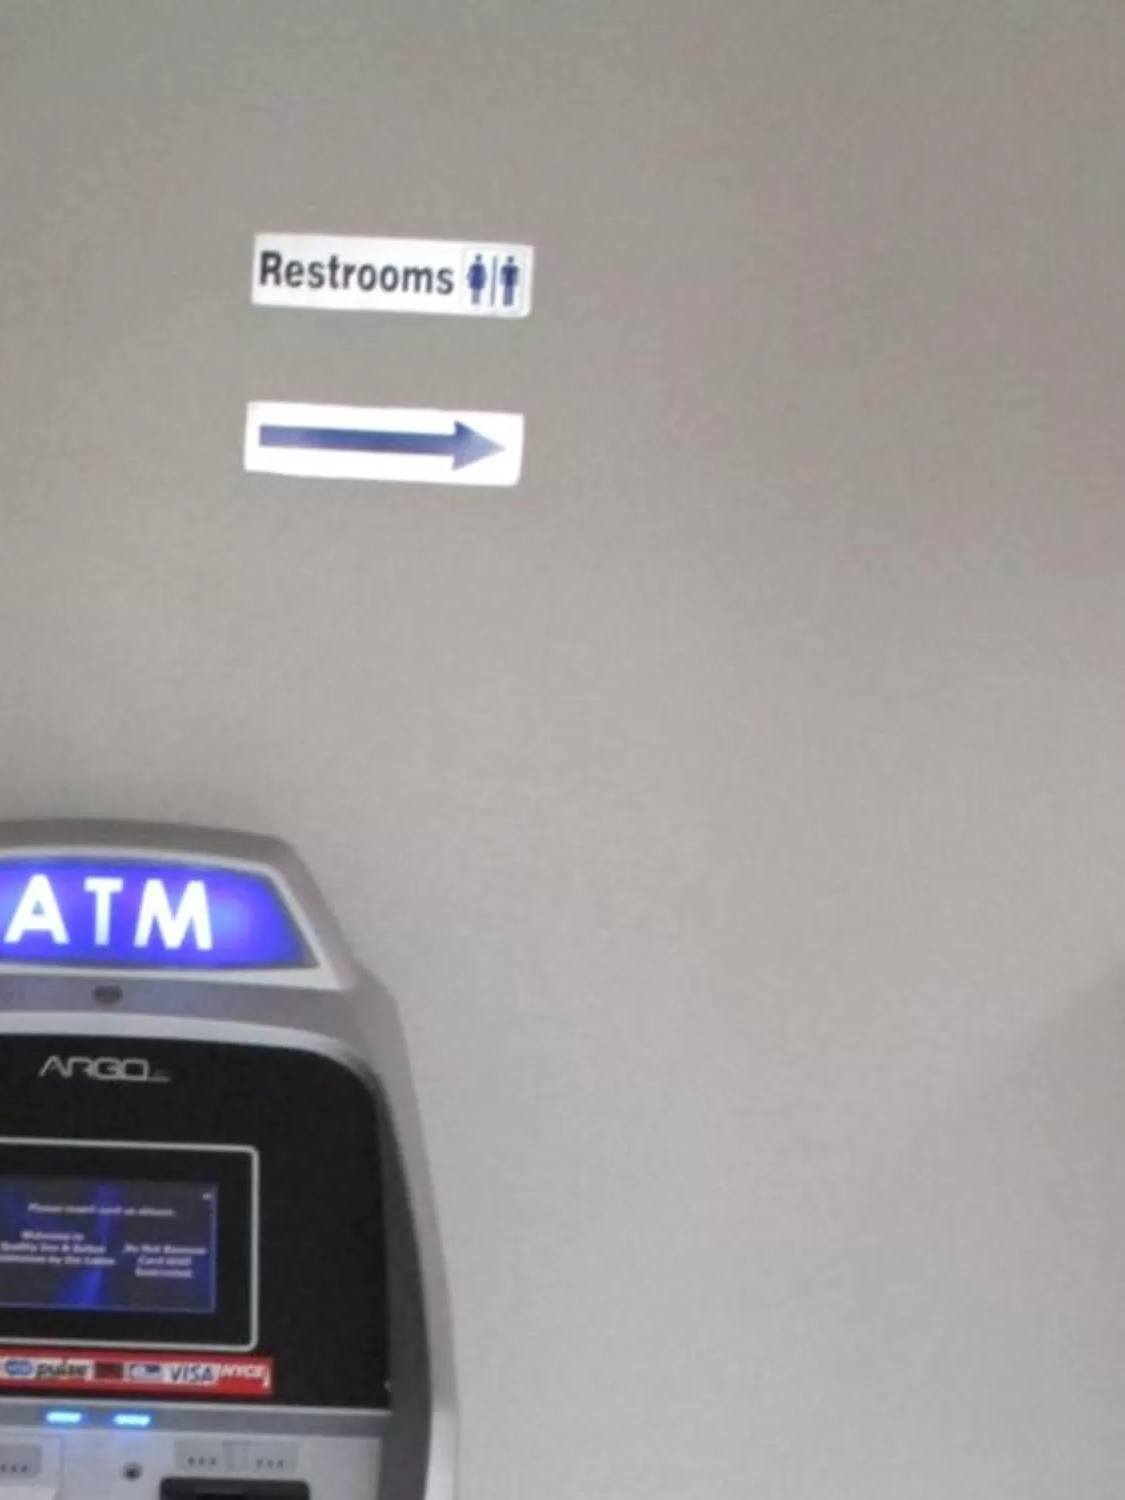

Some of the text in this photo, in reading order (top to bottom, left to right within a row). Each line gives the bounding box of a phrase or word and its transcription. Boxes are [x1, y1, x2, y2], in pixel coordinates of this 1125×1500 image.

[259, 250, 455, 296] Restrooms
[4, 873, 213, 951] ATM
[170, 1362, 213, 1381] VISA
